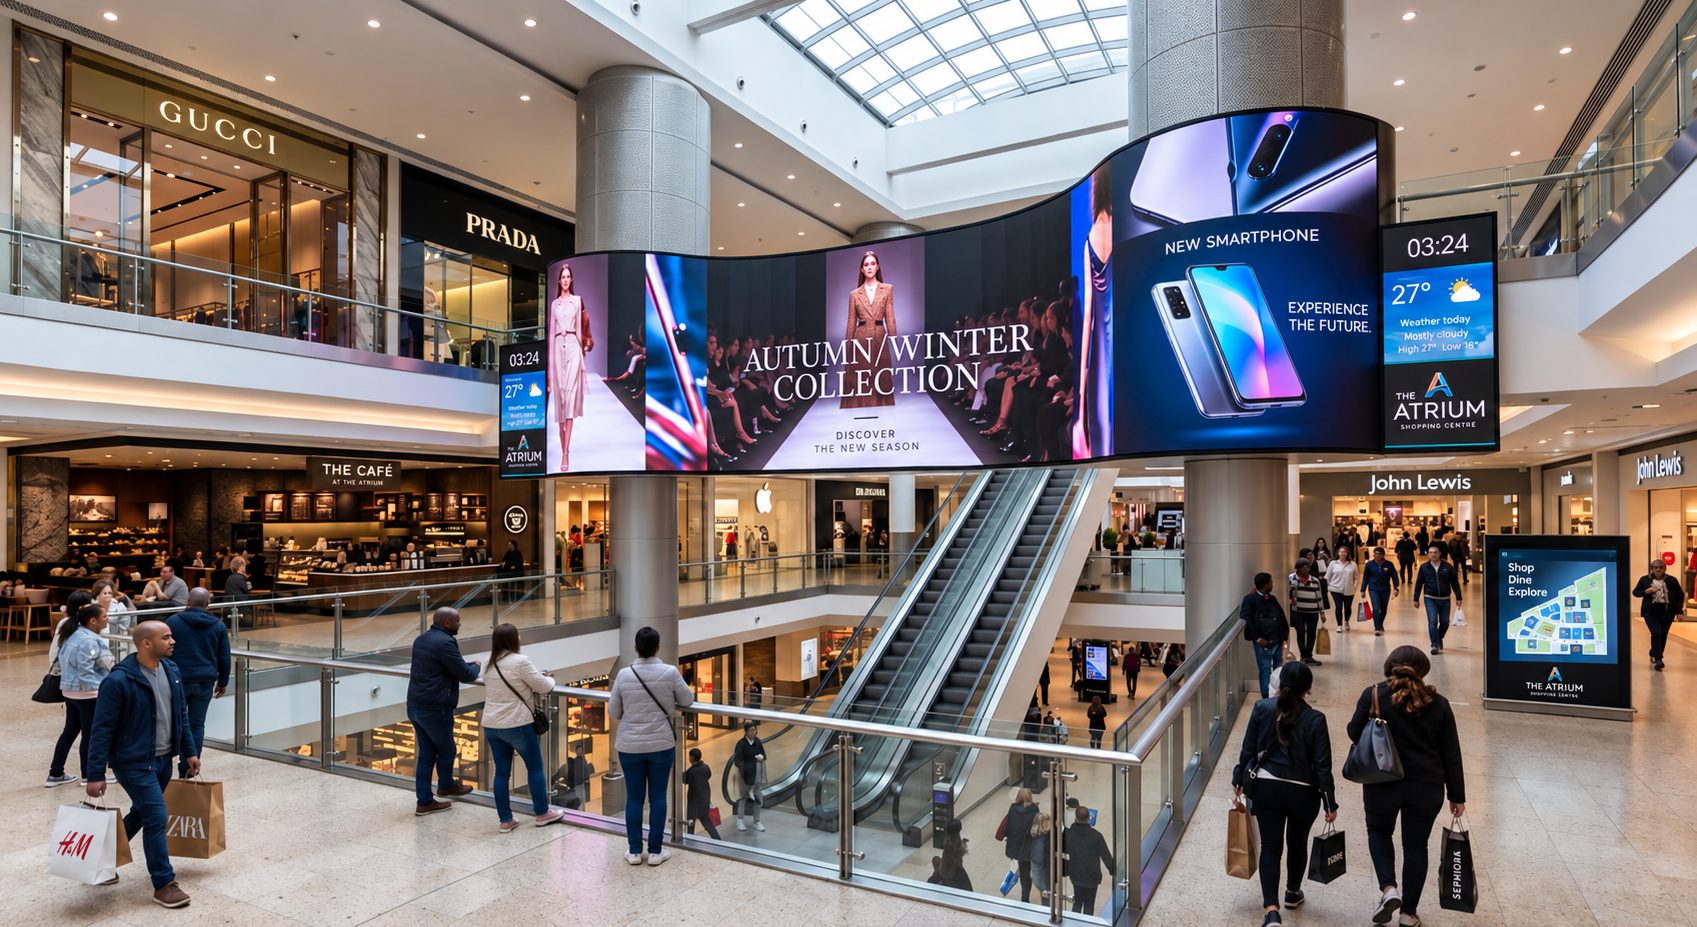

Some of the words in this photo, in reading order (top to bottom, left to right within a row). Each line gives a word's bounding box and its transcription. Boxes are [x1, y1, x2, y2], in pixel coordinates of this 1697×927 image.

[160, 100, 275, 155] GUCCI
[466, 212, 541, 255] PRADA
[1165, 237, 1201, 255] NEW
[1206, 228, 1320, 248] SMARTPHONE
[1407, 233, 1469, 258] 03:24
[1391, 282, 1431, 305] 27°
[1288, 301, 1369, 316] EXPERIENCE
[1289, 318, 1315, 331] THE
[1319, 319, 1372, 333] FUTURE.
[1400, 317, 1440, 327] Weather
[1443, 315, 1471, 325] today
[1404, 331, 1434, 342] Mostly
[1437, 329, 1469, 340] cloudy
[744, 324, 1034, 373] AUTUMN/WINTER
[1398, 345, 1419, 355] High
[1442, 341, 1461, 351] Low
[509, 351, 540, 367] 03:24
[773, 362, 981, 402] COLLECTION
[505, 383, 524, 399] 27°
[1396, 392, 1416, 400] THE
[1393, 400, 1485, 420] ATRIUM
[1400, 422, 1441, 430] SHOPPING
[1444, 421, 1476, 429] CENTRE
[836, 430, 896, 440] DISCOVER
[814, 445, 835, 454] THE
[840, 444, 868, 453] NEW
[872, 442, 920, 451] SEASON
[505, 451, 542, 462] ATRIUM
[322, 463, 351, 476] THE
[357, 463, 393, 477] CAFÉ
[1637, 456, 1654, 485] John
[1655, 450, 1682, 477] Lewis
[1368, 474, 1412, 495] John
[1417, 474, 1472, 490] Lewis
[1508, 563, 1535, 574] Shop
[1508, 575, 1533, 585] Dine
[1508, 587, 1548, 599] Explore
[1526, 682, 1543, 690] THE
[1545, 683, 1584, 693] ATRIUM
[166, 814, 207, 840] ZARA
[57, 830, 94, 861] H&M
